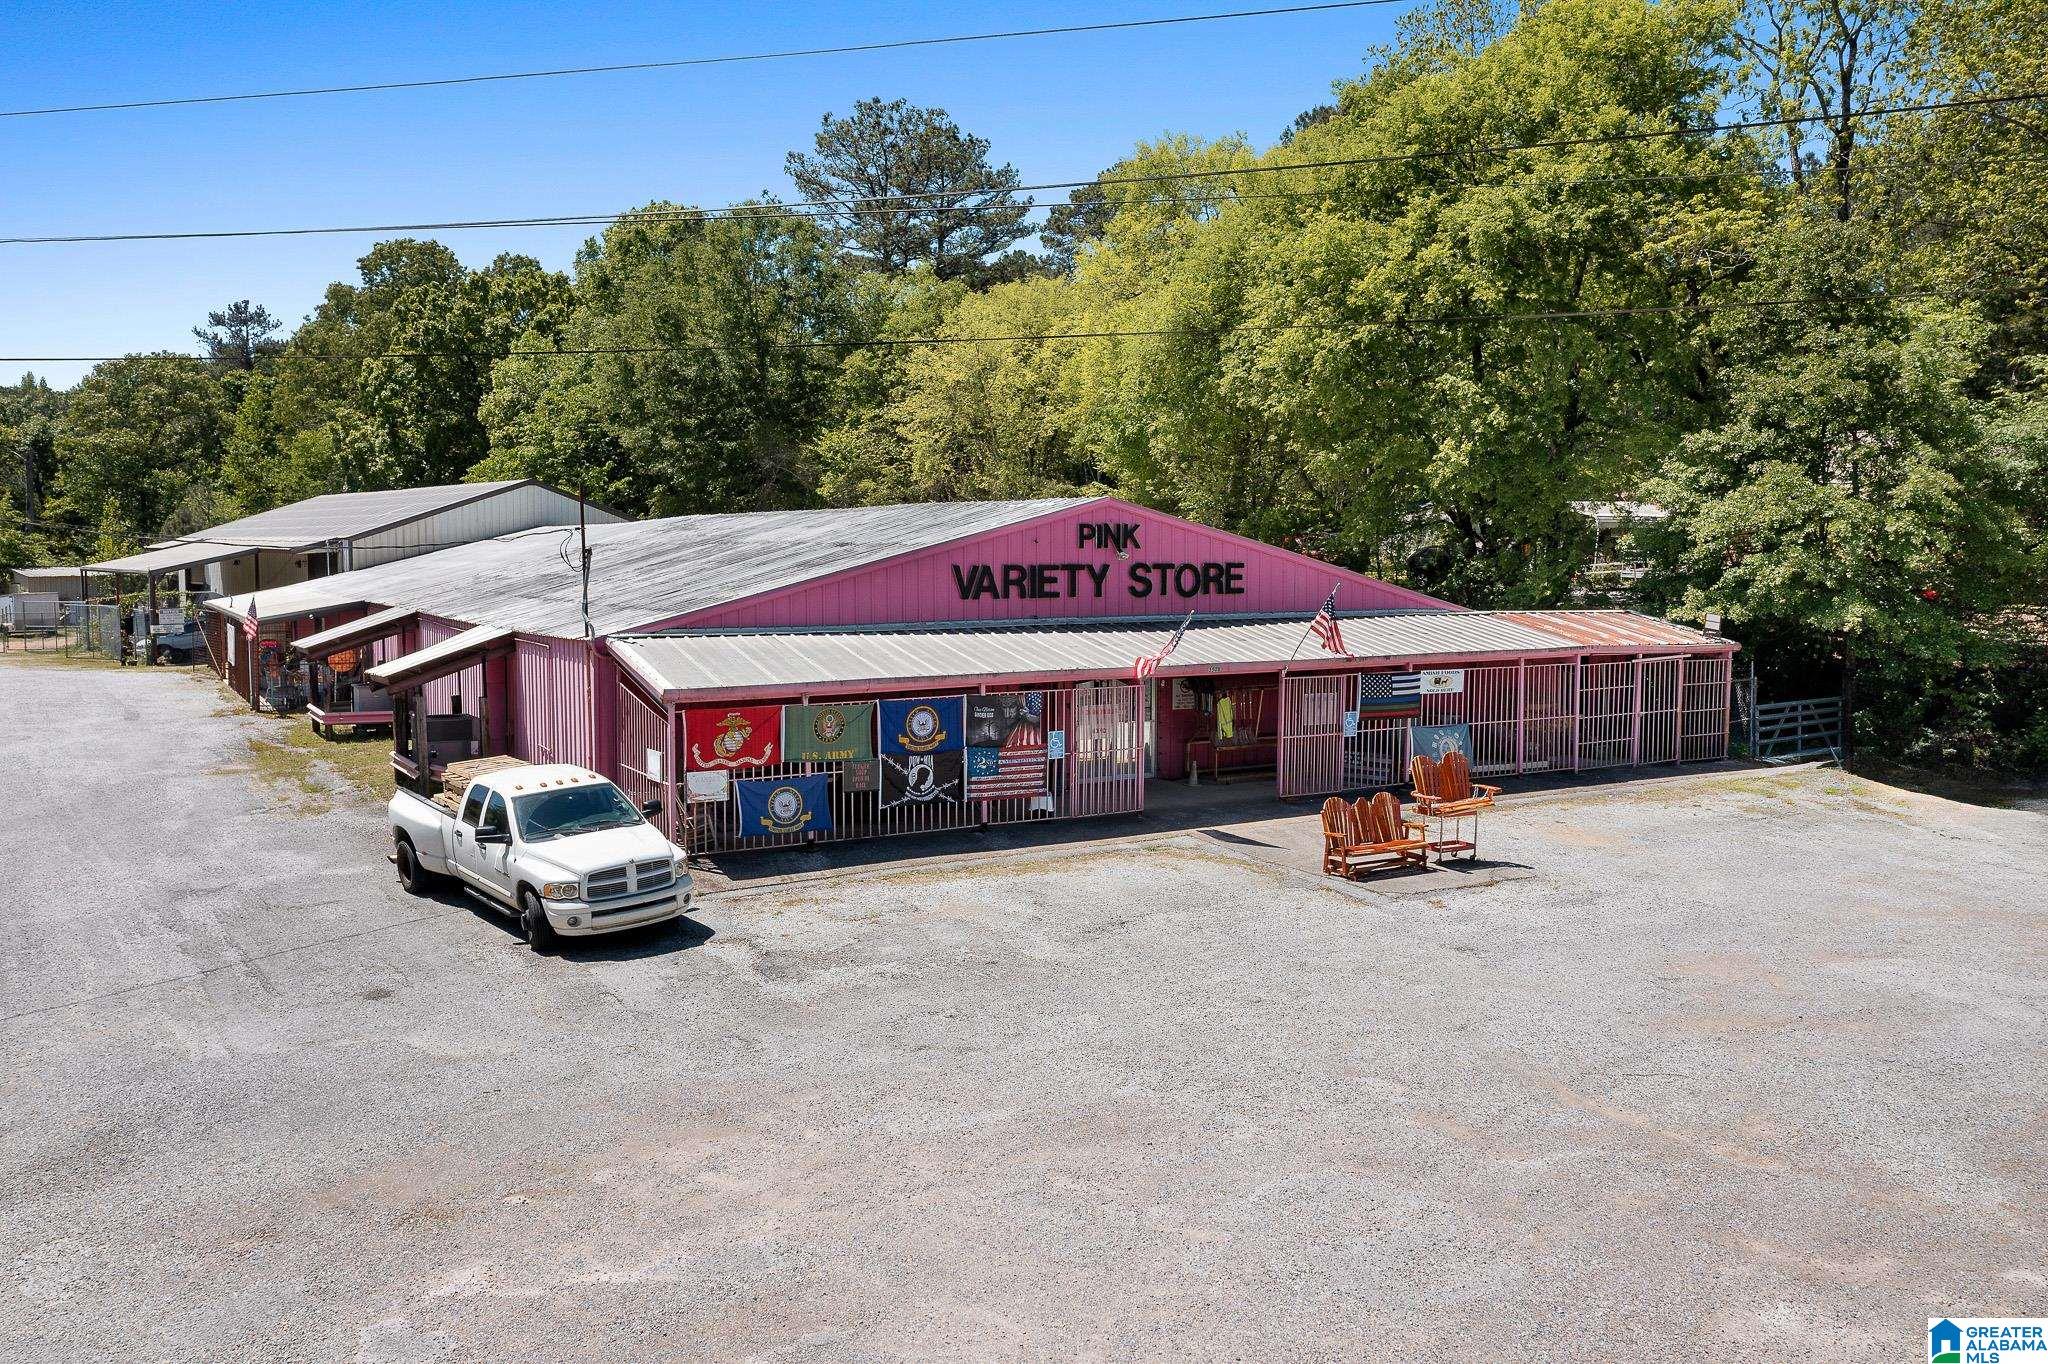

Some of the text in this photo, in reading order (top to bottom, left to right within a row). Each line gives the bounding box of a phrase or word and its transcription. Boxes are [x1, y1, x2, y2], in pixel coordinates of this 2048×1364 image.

[1078, 523, 1141, 549] PINK
[951, 562, 1246, 600] VARIETY STORE
[824, 748, 856, 760] ARMY
